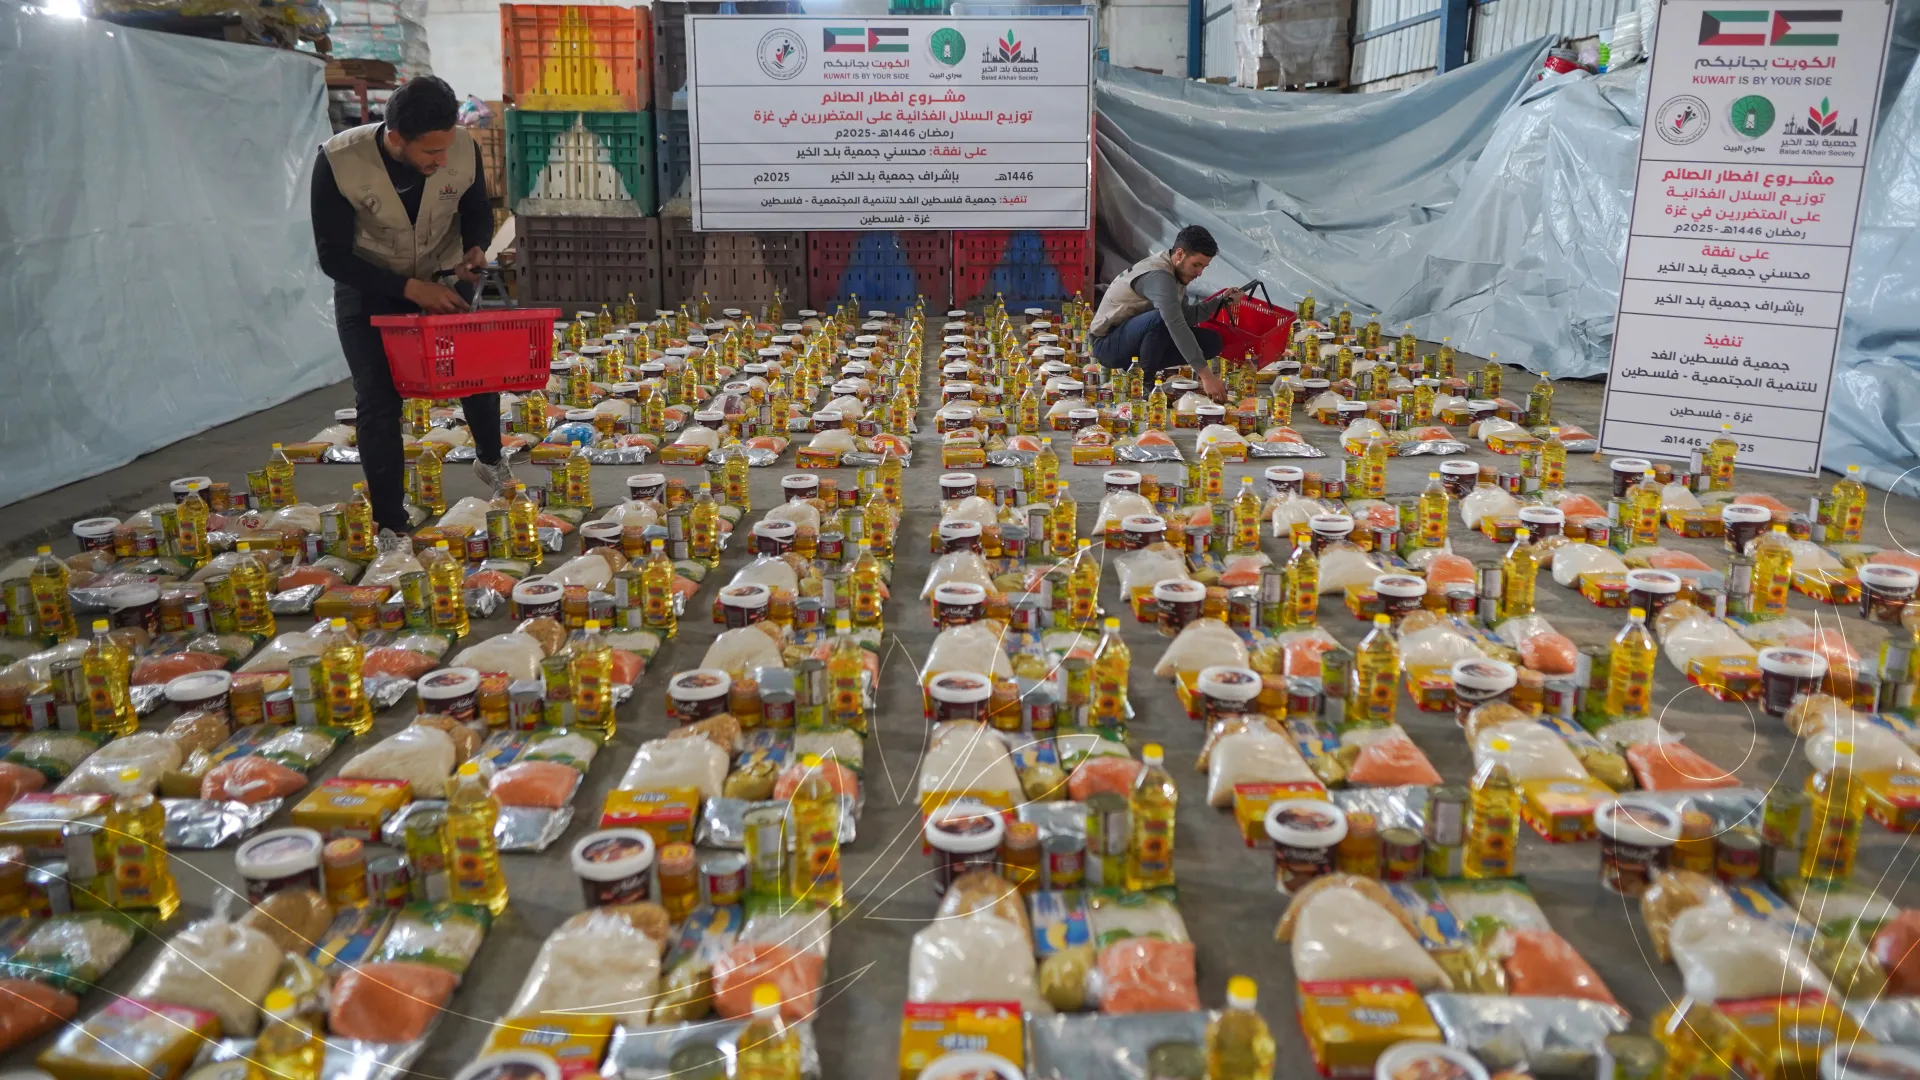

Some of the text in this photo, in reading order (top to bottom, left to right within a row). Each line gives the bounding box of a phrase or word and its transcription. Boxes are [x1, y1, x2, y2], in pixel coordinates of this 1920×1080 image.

[823, 59, 910, 70] الكويت بجانبكم
[982, 65, 1039, 75] جمعية بلد الخير
[1694, 55, 1836, 71] الكويت بجانبكم
[823, 72, 851, 80] KUWAIT
[852, 72, 860, 80] IS
[861, 72, 871, 80] BY
[872, 72, 892, 80] YOUR
[1018, 74, 1039, 82] Society
[1692, 75, 1833, 86] KUWAIT IS BY YOUR SIDE
[821, 91, 864, 106] الصائم
[867, 90, 904, 105] افطار
[753, 109, 1033, 128] توزيع السلال الغذائية على المتضررين في غزة
[918, 127, 954, 140] رمضان
[1780, 138, 1857, 149] جمعية بلد الخير
[796, 146, 821, 160] الخير
[823, 146, 841, 159] بلد
[844, 146, 881, 159] جمعية
[884, 146, 927, 160] محسني
[964, 146, 988, 159] على
[1828, 150, 1856, 158] Society
[753, 171, 790, 185] 2025م
[830, 168, 960, 184] بإشراف جمعية بلد الخير
[1661, 168, 1713, 183] الصائم
[1715, 170, 1760, 185] افطار
[760, 196, 803, 208] فلسطين
[811, 195, 861, 207] المجتمعية
[864, 195, 897, 207] للتنمية
[899, 195, 919, 205] الغد
[922, 195, 963, 207] فلسطين
[965, 195, 997, 206] جمعية
[1666, 185, 1826, 207] توزيع السلال الغذائية
[859, 214, 906, 228] فلسطين
[913, 214, 931, 225] غزة
[1665, 204, 1821, 225] على المتضررين في غزة
[1765, 227, 1807, 240] رمضان
[1701, 245, 1770, 263] على نفقة
[1657, 262, 1811, 283] محسني جمعية بلد الخير
[1655, 293, 1805, 317] بإشراف جمعية بلد الخير
[1703, 335, 1744, 350] تنفيذ
[1650, 349, 1791, 374] جمعية فلسطين الغد
[1621, 367, 1680, 381] فلسطين
[1691, 373, 1763, 388] المجتمعية
[1765, 379, 1818, 393] للتنمية
[1670, 406, 1723, 420] فلسطين
[1733, 412, 1753, 424] غزة
[1660, 435, 1702, 447] 1446هـ
